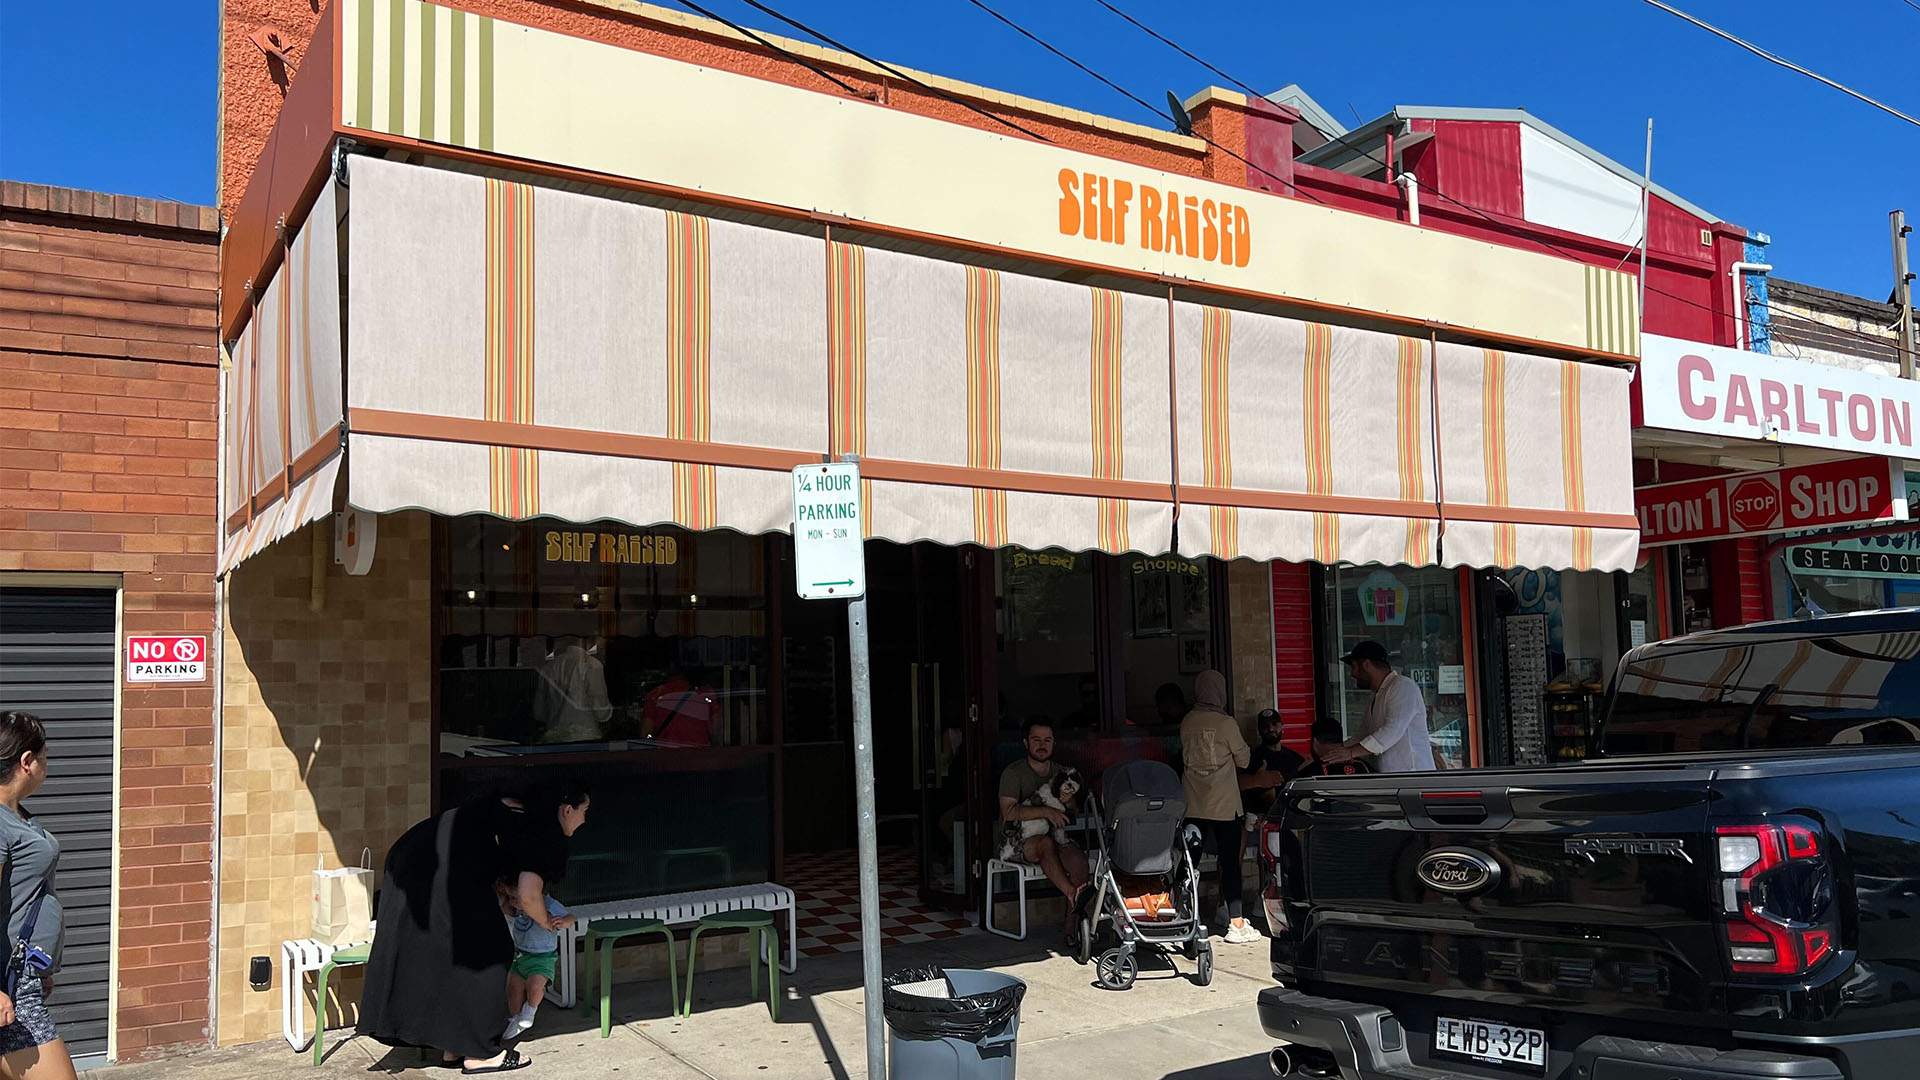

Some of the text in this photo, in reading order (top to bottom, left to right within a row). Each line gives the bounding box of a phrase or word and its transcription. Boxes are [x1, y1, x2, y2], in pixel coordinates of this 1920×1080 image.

[1058, 168, 1133, 245] SELF
[1677, 354, 1913, 447] CARLTON
[816, 474, 851, 492] HOUR
[799, 502, 856, 520] PARKING
[1636, 498, 1702, 538] LTON
[1735, 495, 1774, 513] STOP
[1790, 475, 1879, 520] SHOP
[807, 529, 823, 539] MON
[833, 528, 848, 539] SUN
[546, 531, 596, 562] SELF
[1013, 552, 1200, 576] Bread Shoppe
[133, 641, 166, 659] NO
[136, 664, 197, 674] PARKING
[1413, 669, 1435, 683] OPEN
[1564, 838, 1692, 863] RAPTOR
[1431, 860, 1469, 882] Ford
